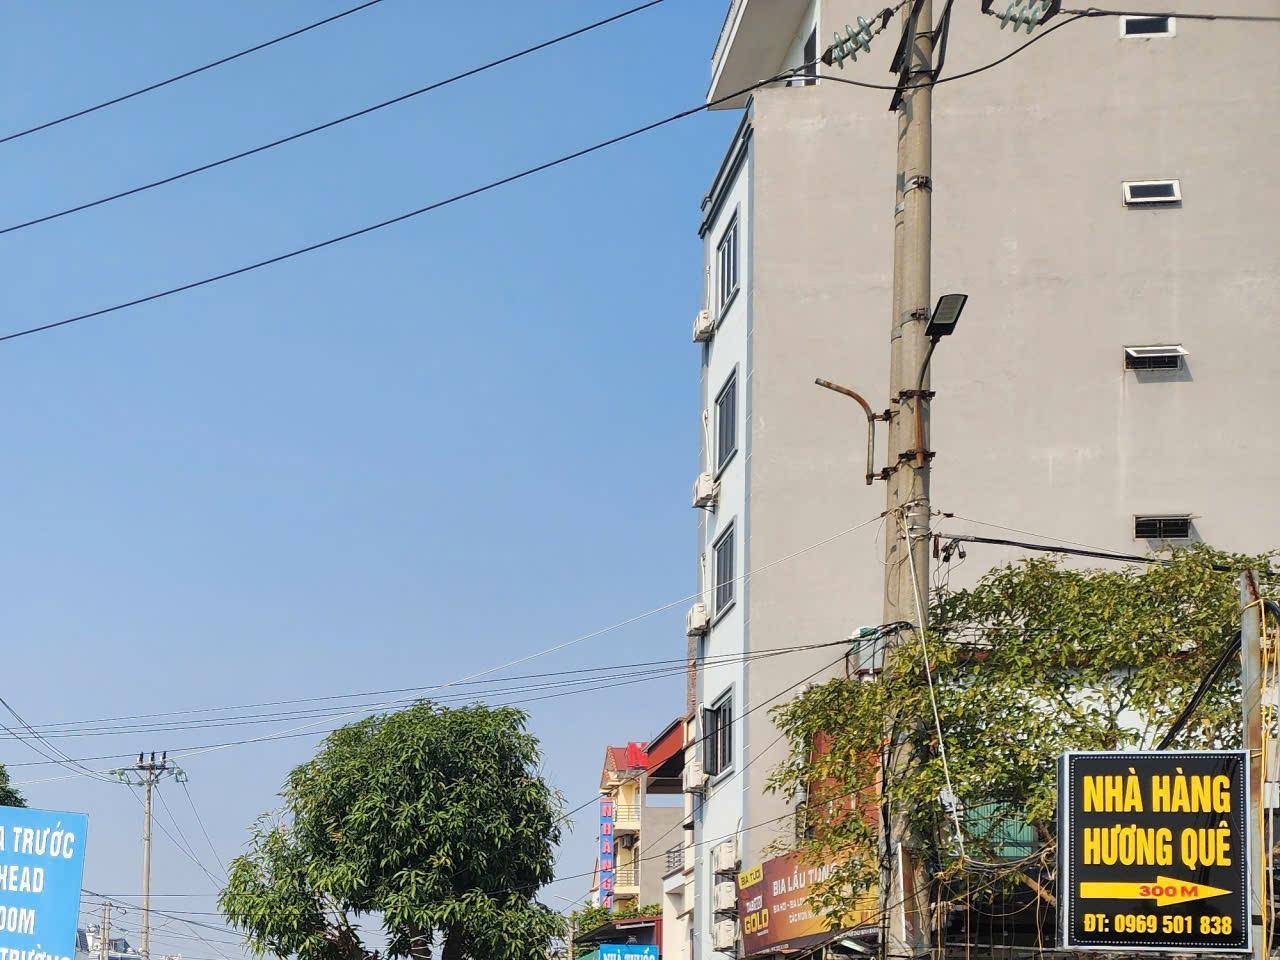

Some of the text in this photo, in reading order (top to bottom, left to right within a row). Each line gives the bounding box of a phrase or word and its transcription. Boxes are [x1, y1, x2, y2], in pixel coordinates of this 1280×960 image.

[1083, 767, 1231, 813] NHÀ HÀNG
[13, 821, 75, 859] TRƯỚC
[1083, 820, 1232, 871] HƯƠNG QUÊ
[773, 878, 787, 897] BIA
[1139, 885, 1199, 897] 300 M
[744, 908, 769, 935] GOLD
[1084, 913, 1232, 935] ĐT: 0969 501 838
